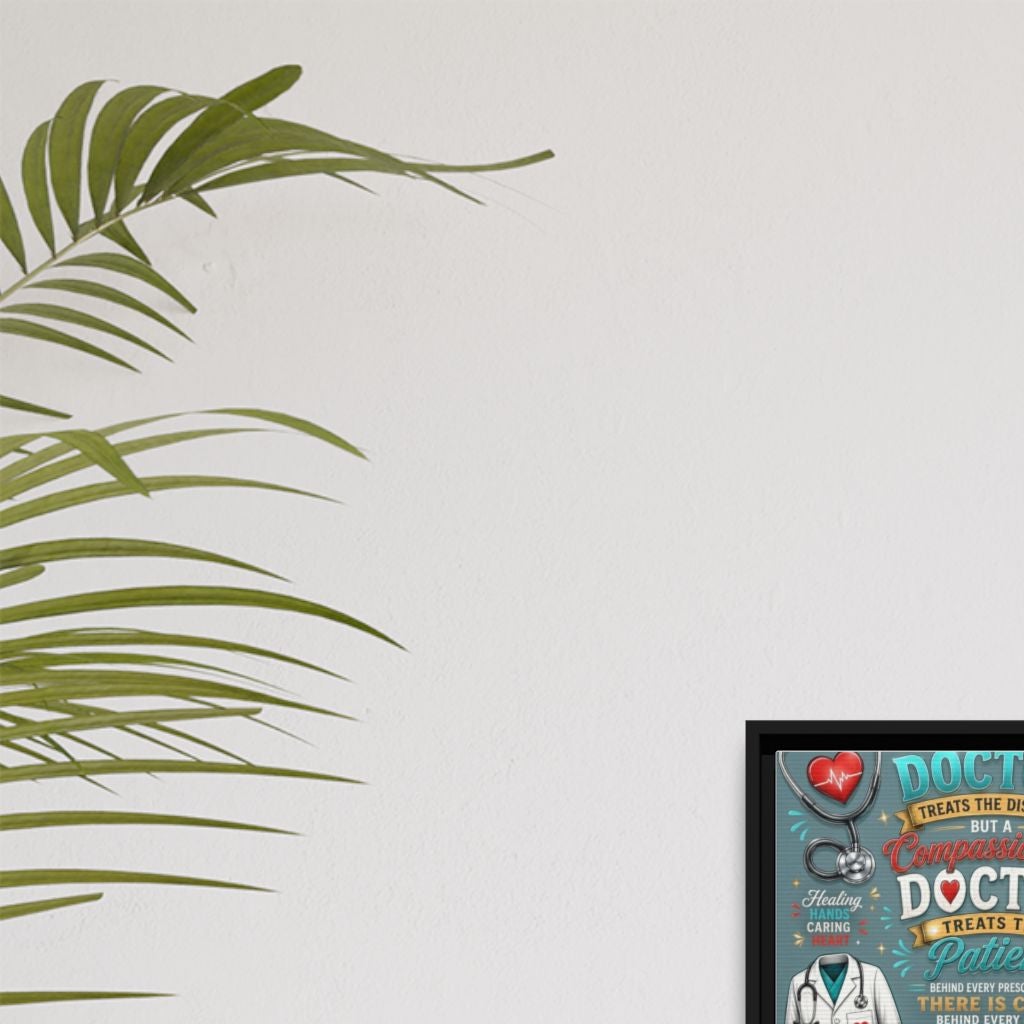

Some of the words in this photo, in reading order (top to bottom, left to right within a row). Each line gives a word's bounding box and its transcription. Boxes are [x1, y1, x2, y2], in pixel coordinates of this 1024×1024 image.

[918, 798, 970, 820] TREATS
[975, 797, 1001, 811] THE
[971, 820, 998, 833] BUT
[1002, 820, 1012, 833] A
[802, 889, 863, 912] Healing
[809, 908, 850, 920] HANDS
[806, 921, 851, 933] CARING
[942, 917, 1006, 934] TREATS
[930, 983, 964, 993] BEHIND
[966, 983, 995, 993] EVERY
[917, 996, 981, 1012] THERE
[988, 996, 1006, 1012] IS
[936, 1015, 979, 1024] BEHIND
[984, 1015, 1019, 1024] EVERY
